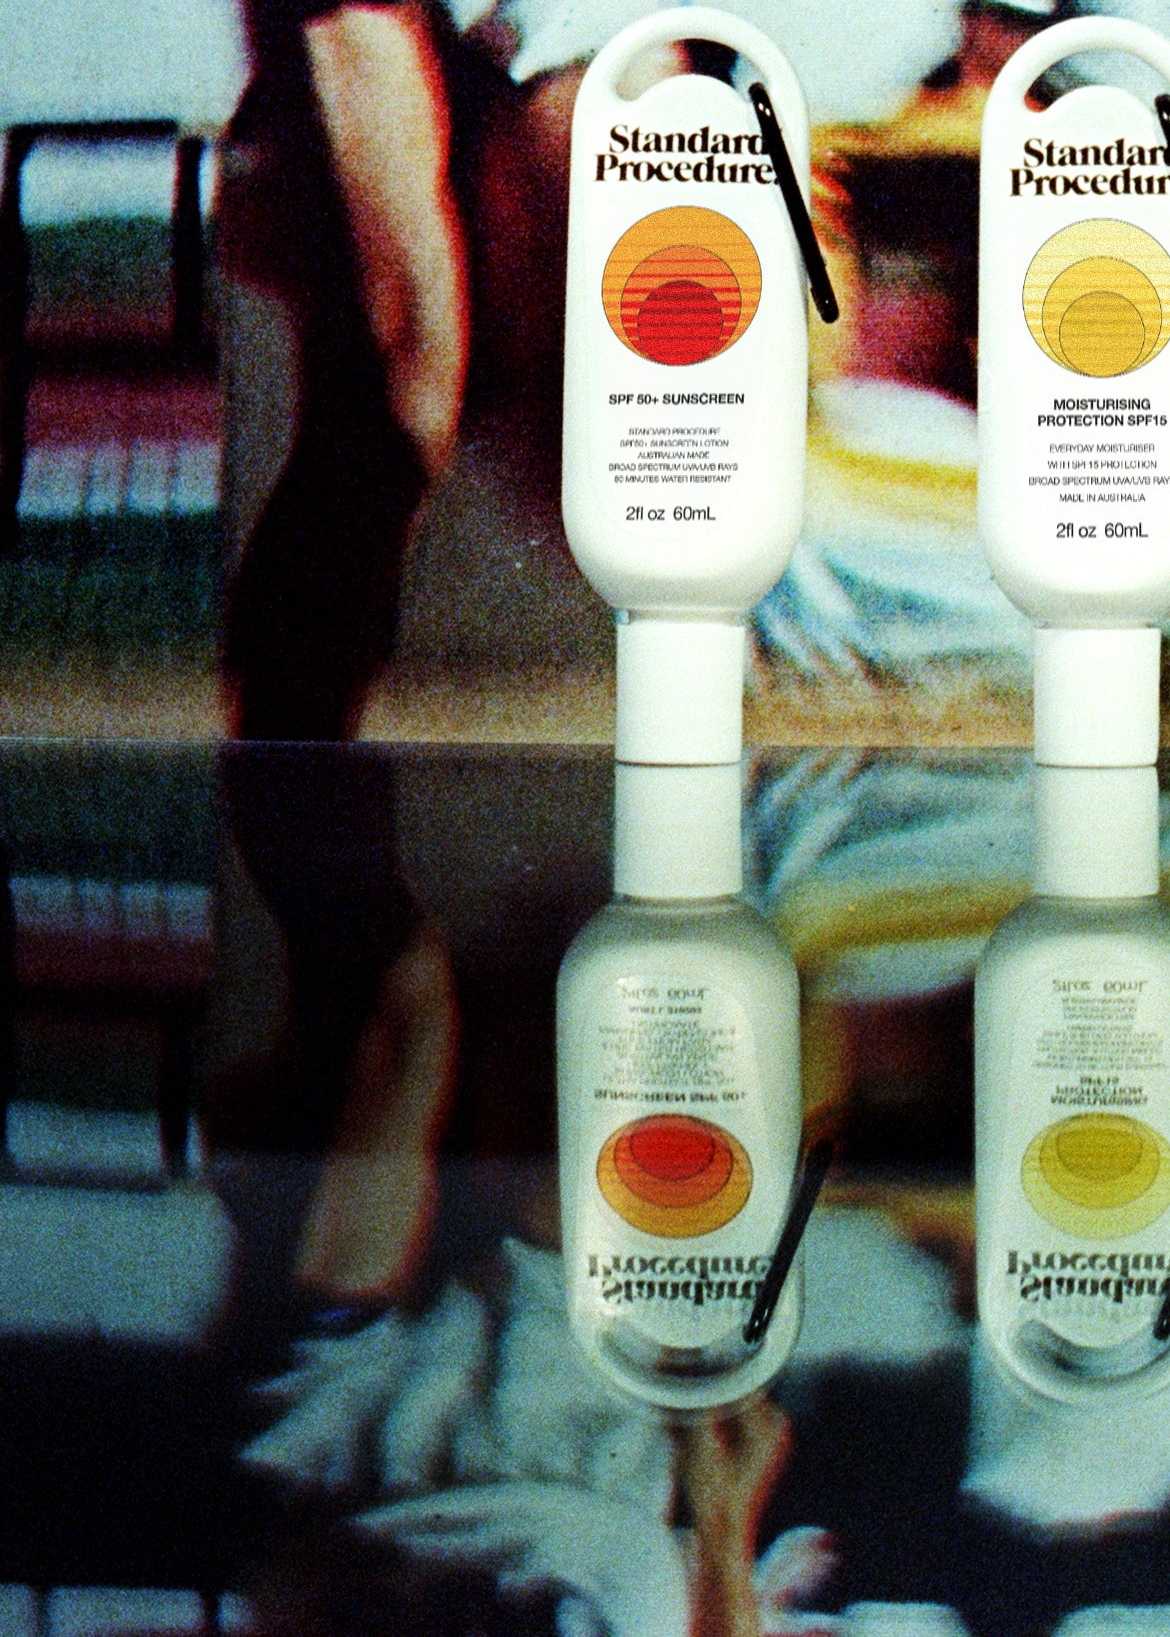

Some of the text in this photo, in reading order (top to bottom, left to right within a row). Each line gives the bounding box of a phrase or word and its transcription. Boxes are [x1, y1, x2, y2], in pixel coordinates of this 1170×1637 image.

[609, 124, 769, 155] Standard
[609, 392, 744, 405] SPF 50+ SUNSCREEN
[1054, 398, 1150, 411] MOISTURISING
[1038, 414, 1167, 427] PROTECTION SPF15
[1050, 444, 1154, 452] EVERYDAY MOISTURISER
[638, 451, 709, 459] AUSTRALIAN MADE
[609, 463, 636, 471] BROAD
[638, 463, 680, 471] SPECTRUM
[718, 463, 738, 471] RAYS
[1048, 461, 1069, 469] WITH
[1101, 460, 1157, 469] PROTECTION
[625, 475, 659, 483] MINUTES
[661, 475, 688, 483] WATER
[690, 475, 731, 483] RESISTANT
[1029, 477, 1060, 485] BROAD
[1062, 477, 1110, 485] SPECTRUM
[1060, 493, 1145, 502] MADE IN AUSTRALIA
[626, 506, 716, 521] 2fl oz 60mL
[1056, 522, 1148, 538] 2fl oz 60mL
